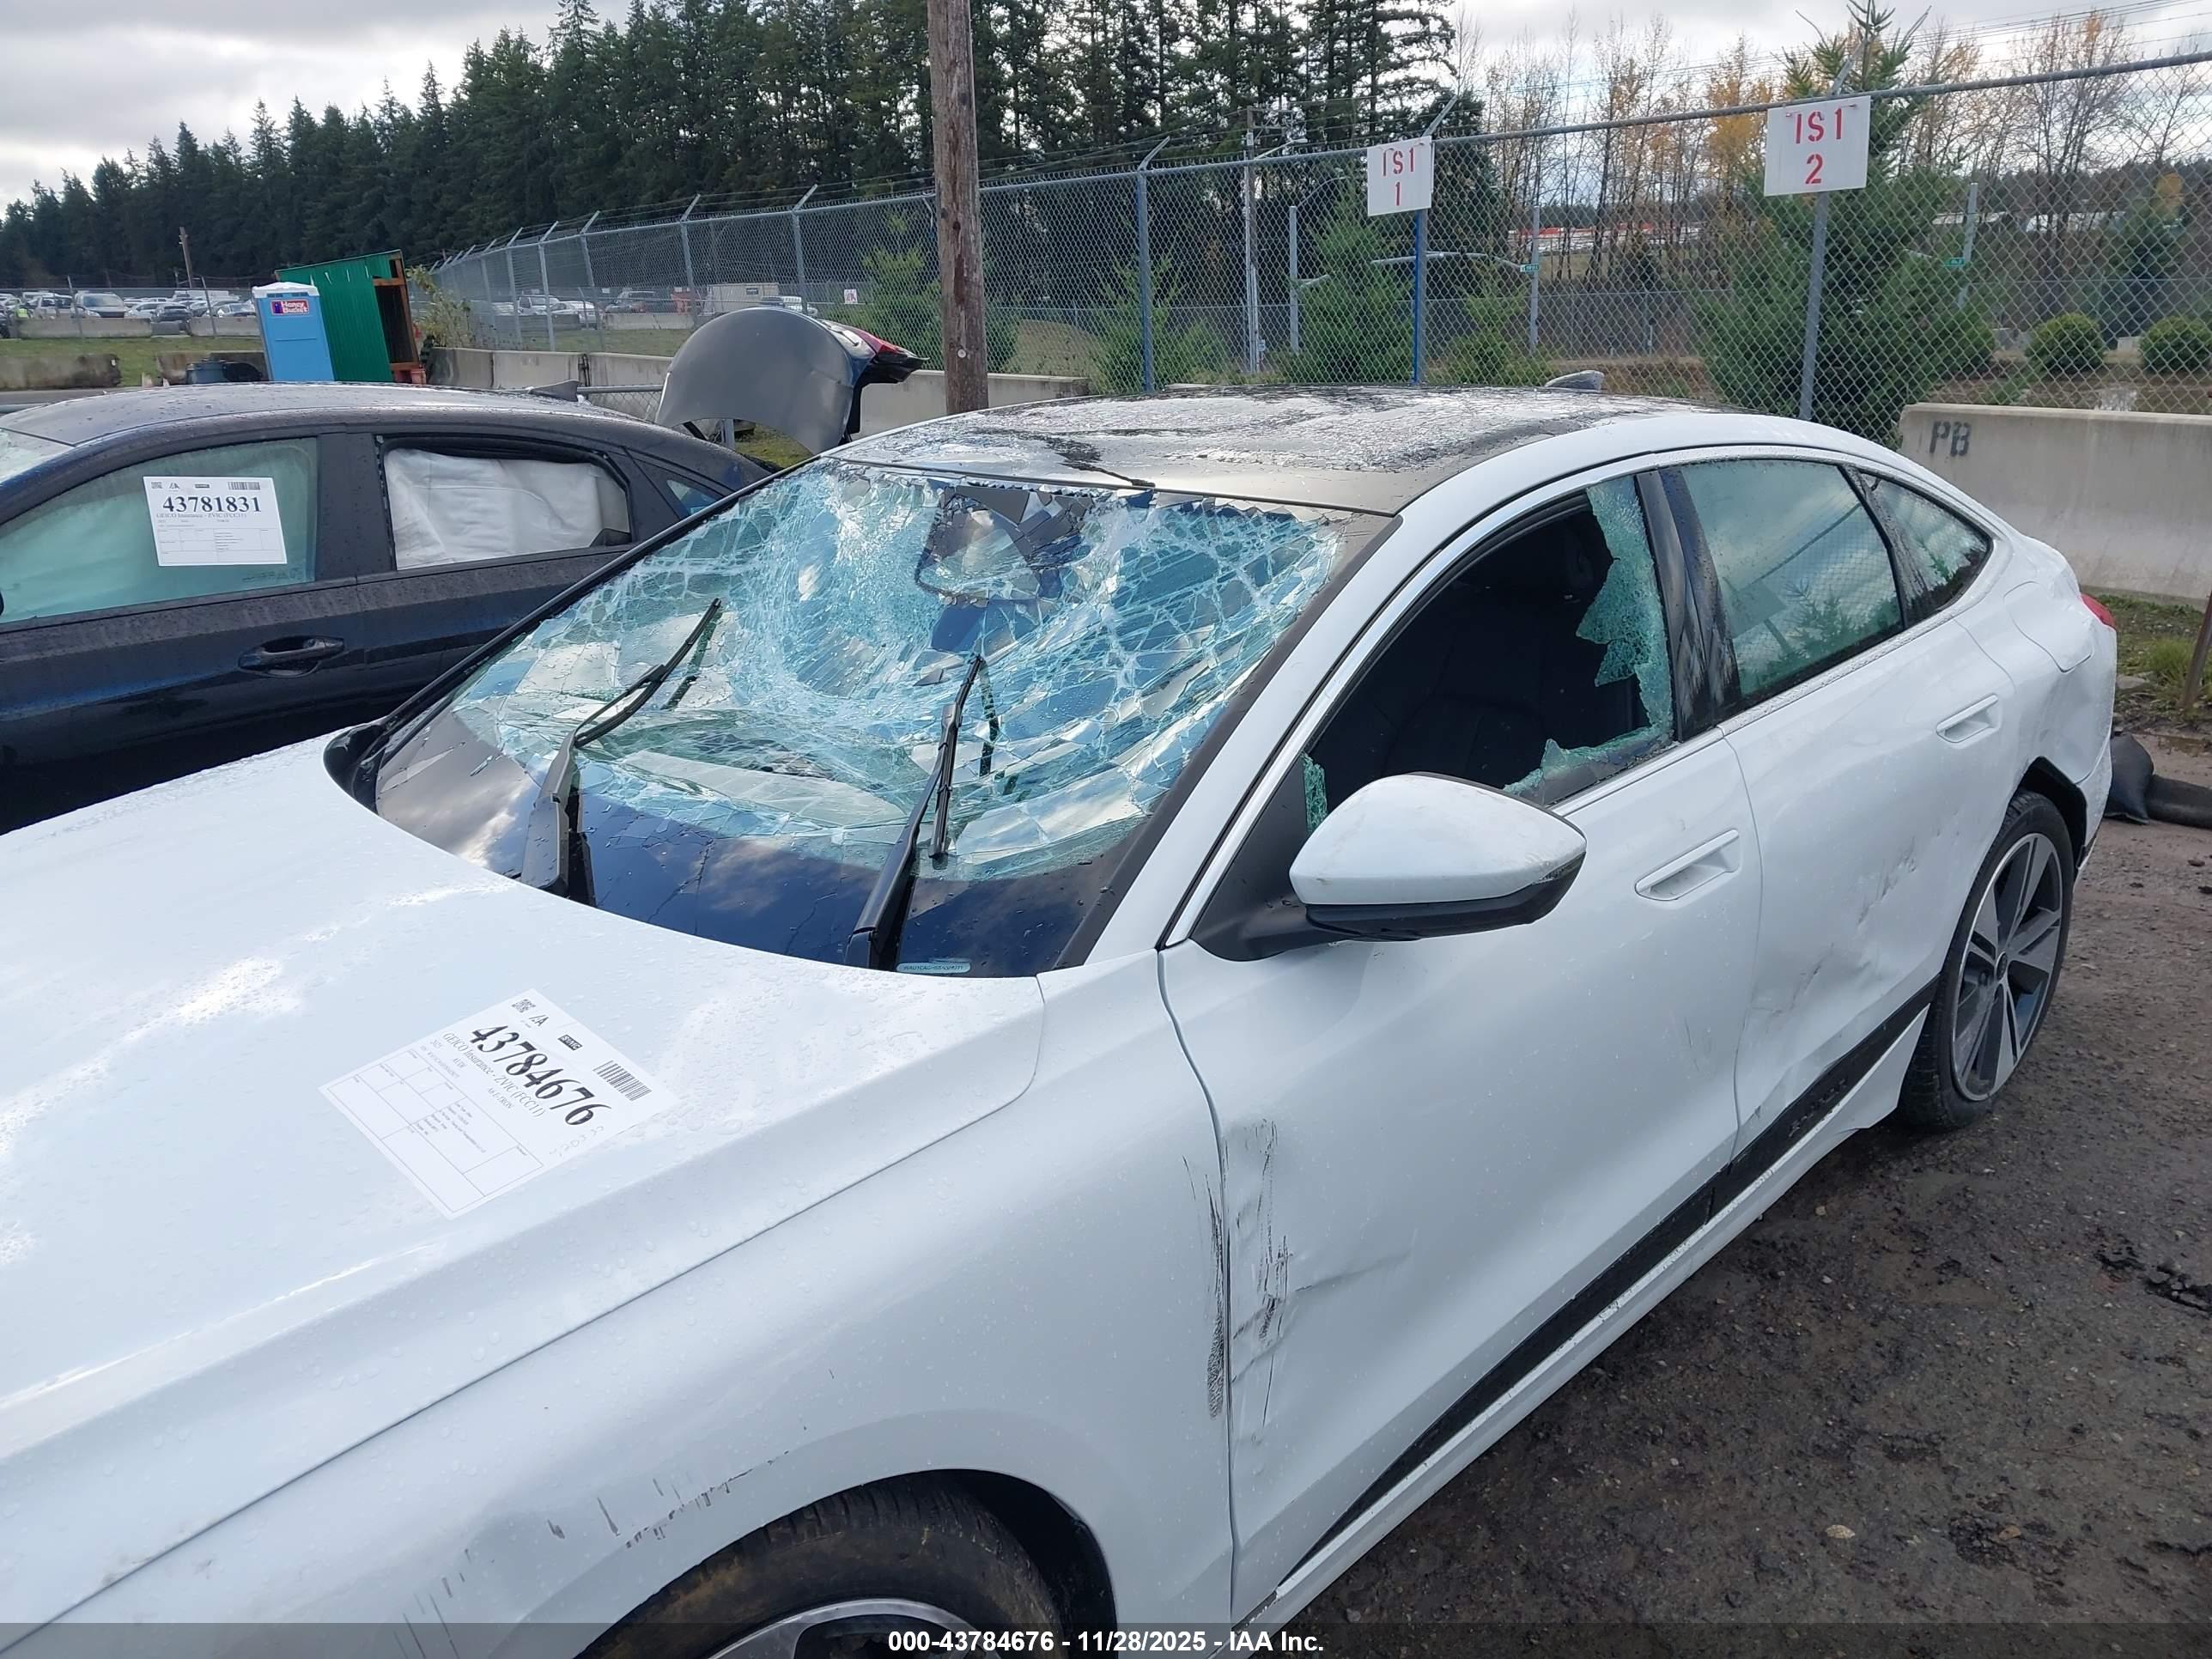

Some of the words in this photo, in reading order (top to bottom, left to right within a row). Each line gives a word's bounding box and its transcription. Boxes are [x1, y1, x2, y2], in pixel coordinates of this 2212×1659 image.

[1805, 154, 1823, 185] 2
[1395, 181, 1401, 206] 1
[1929, 421, 1972, 457] PB
[162, 495, 262, 513] 43781831
[442, 1032, 468, 1052] GEICO
[463, 1048, 495, 1074] Insurance
[494, 1074, 520, 1092] ZVIC
[510, 1091, 546, 1117] (FCC11)
[471, 1024, 611, 1126] 43784676
